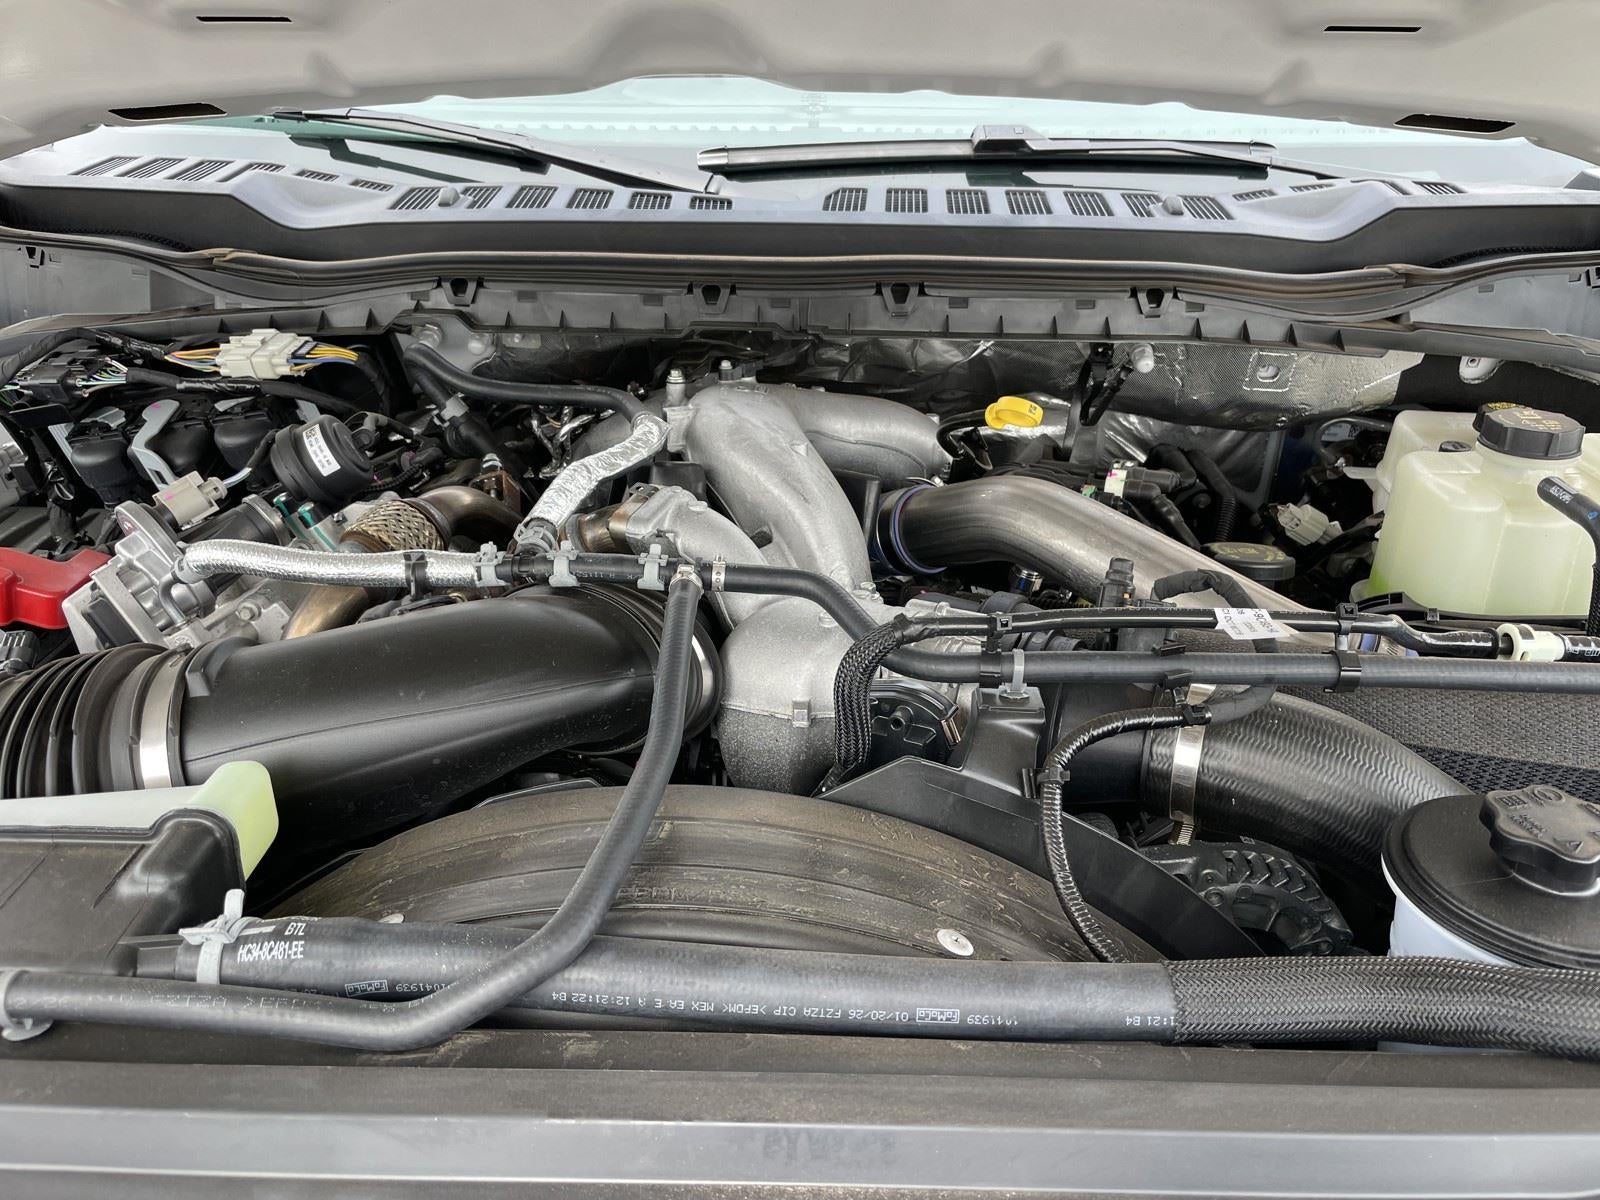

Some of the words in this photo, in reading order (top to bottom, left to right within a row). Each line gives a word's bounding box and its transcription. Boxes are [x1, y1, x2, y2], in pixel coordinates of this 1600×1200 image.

[284, 922, 307, 936] BTL
[345, 980, 388, 997] FoMoCo
[395, 983, 446, 993] 1041939
[551, 990, 567, 1002] B4
[571, 992, 630, 1005] 12:21:22
[690, 1000, 714, 1012] MEX
[773, 1005, 796, 1017] CIP
[803, 1006, 842, 1018] FZTZA
[847, 1009, 909, 1022] 01/20/26
[917, 1008, 959, 1023] FoMoCo
[1125, 1015, 1142, 1027] B4
